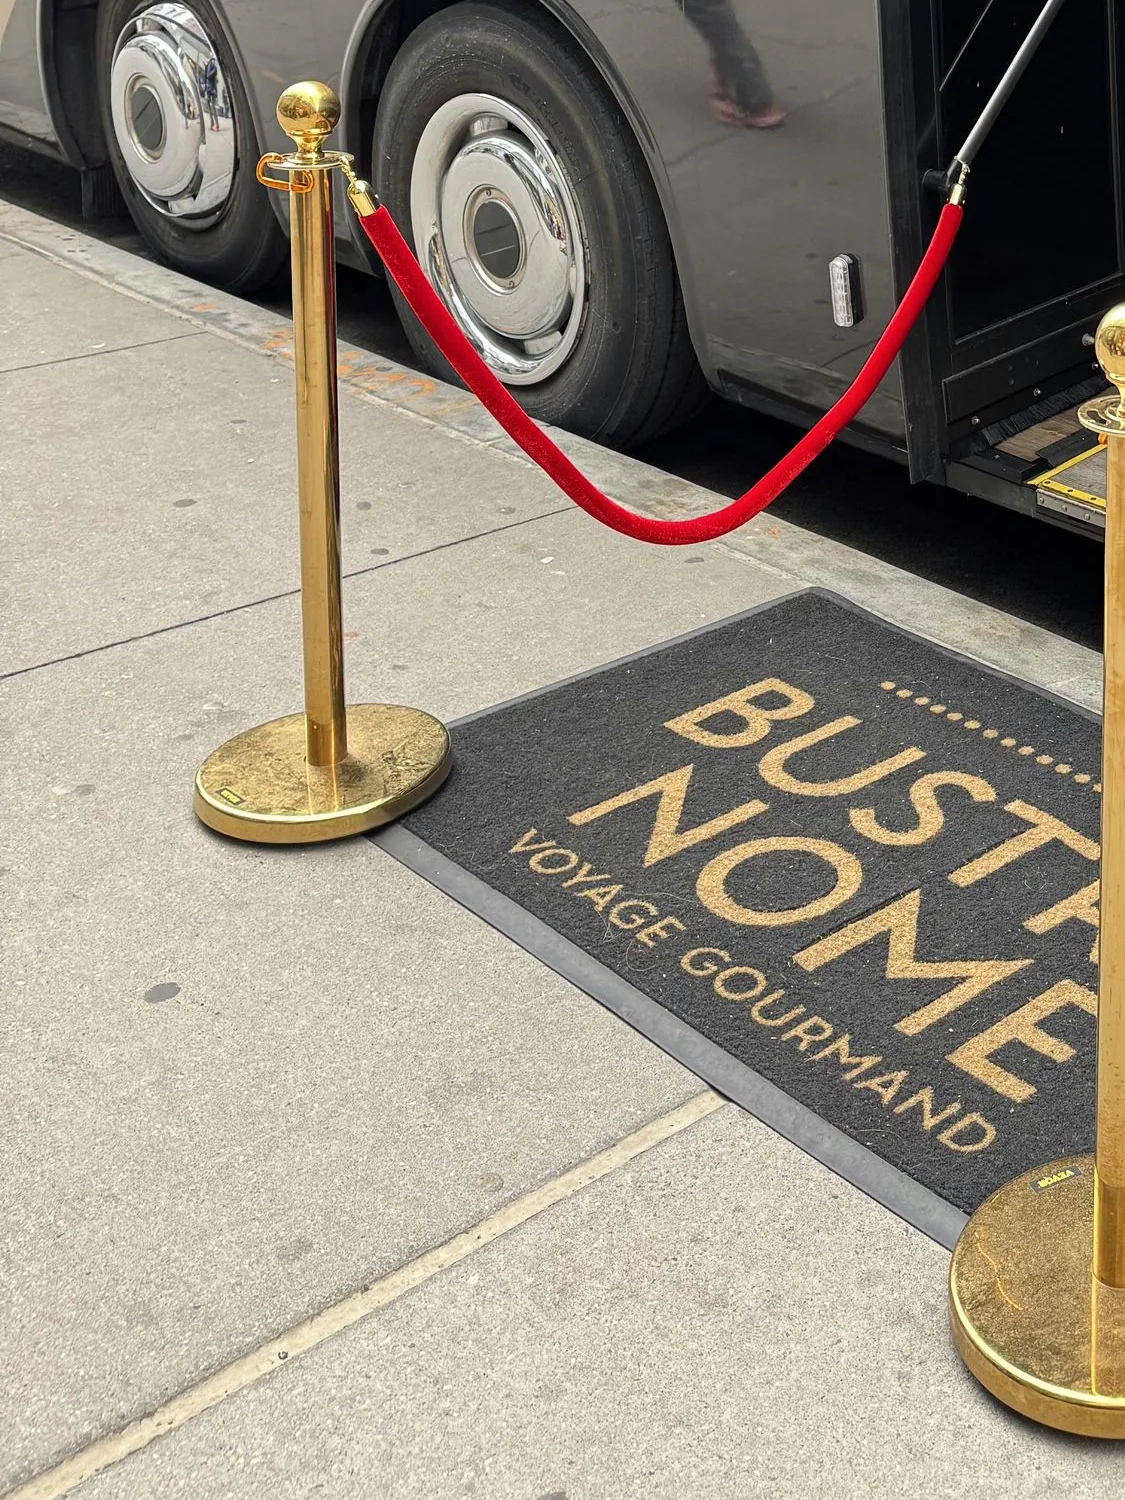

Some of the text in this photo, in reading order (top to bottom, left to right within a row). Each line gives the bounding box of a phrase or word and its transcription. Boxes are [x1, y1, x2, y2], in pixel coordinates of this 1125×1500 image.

[509, 829, 998, 1154] VOYAGE GOURMAND
[567, 764, 1098, 1103] NOME
